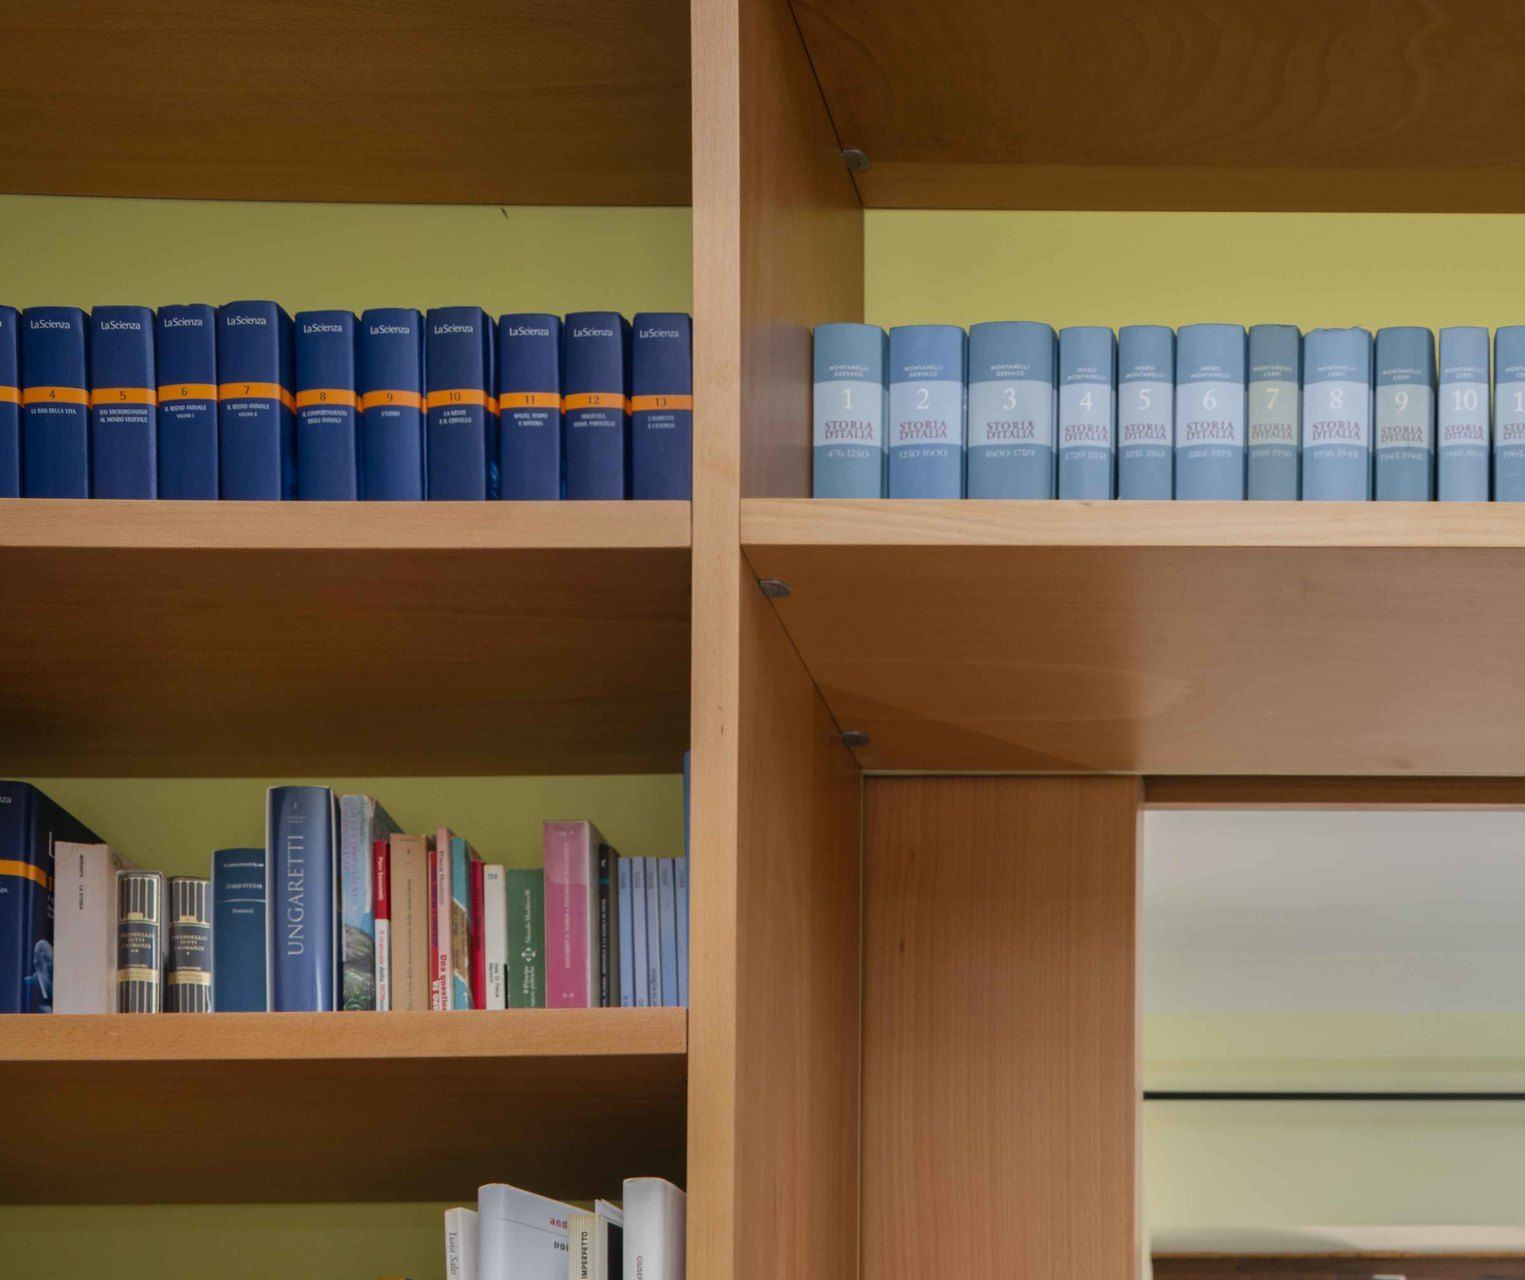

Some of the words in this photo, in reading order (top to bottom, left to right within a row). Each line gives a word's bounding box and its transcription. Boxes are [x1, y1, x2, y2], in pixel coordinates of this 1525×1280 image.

[181, 386, 189, 397] 6
[243, 384, 251, 395] 7
[842, 388, 855, 411] 1
[1002, 388, 1017, 411] 3
[824, 420, 873, 431] STORIA
[986, 420, 1034, 431] STORIA
[288, 835, 304, 956] UNGARETTI
